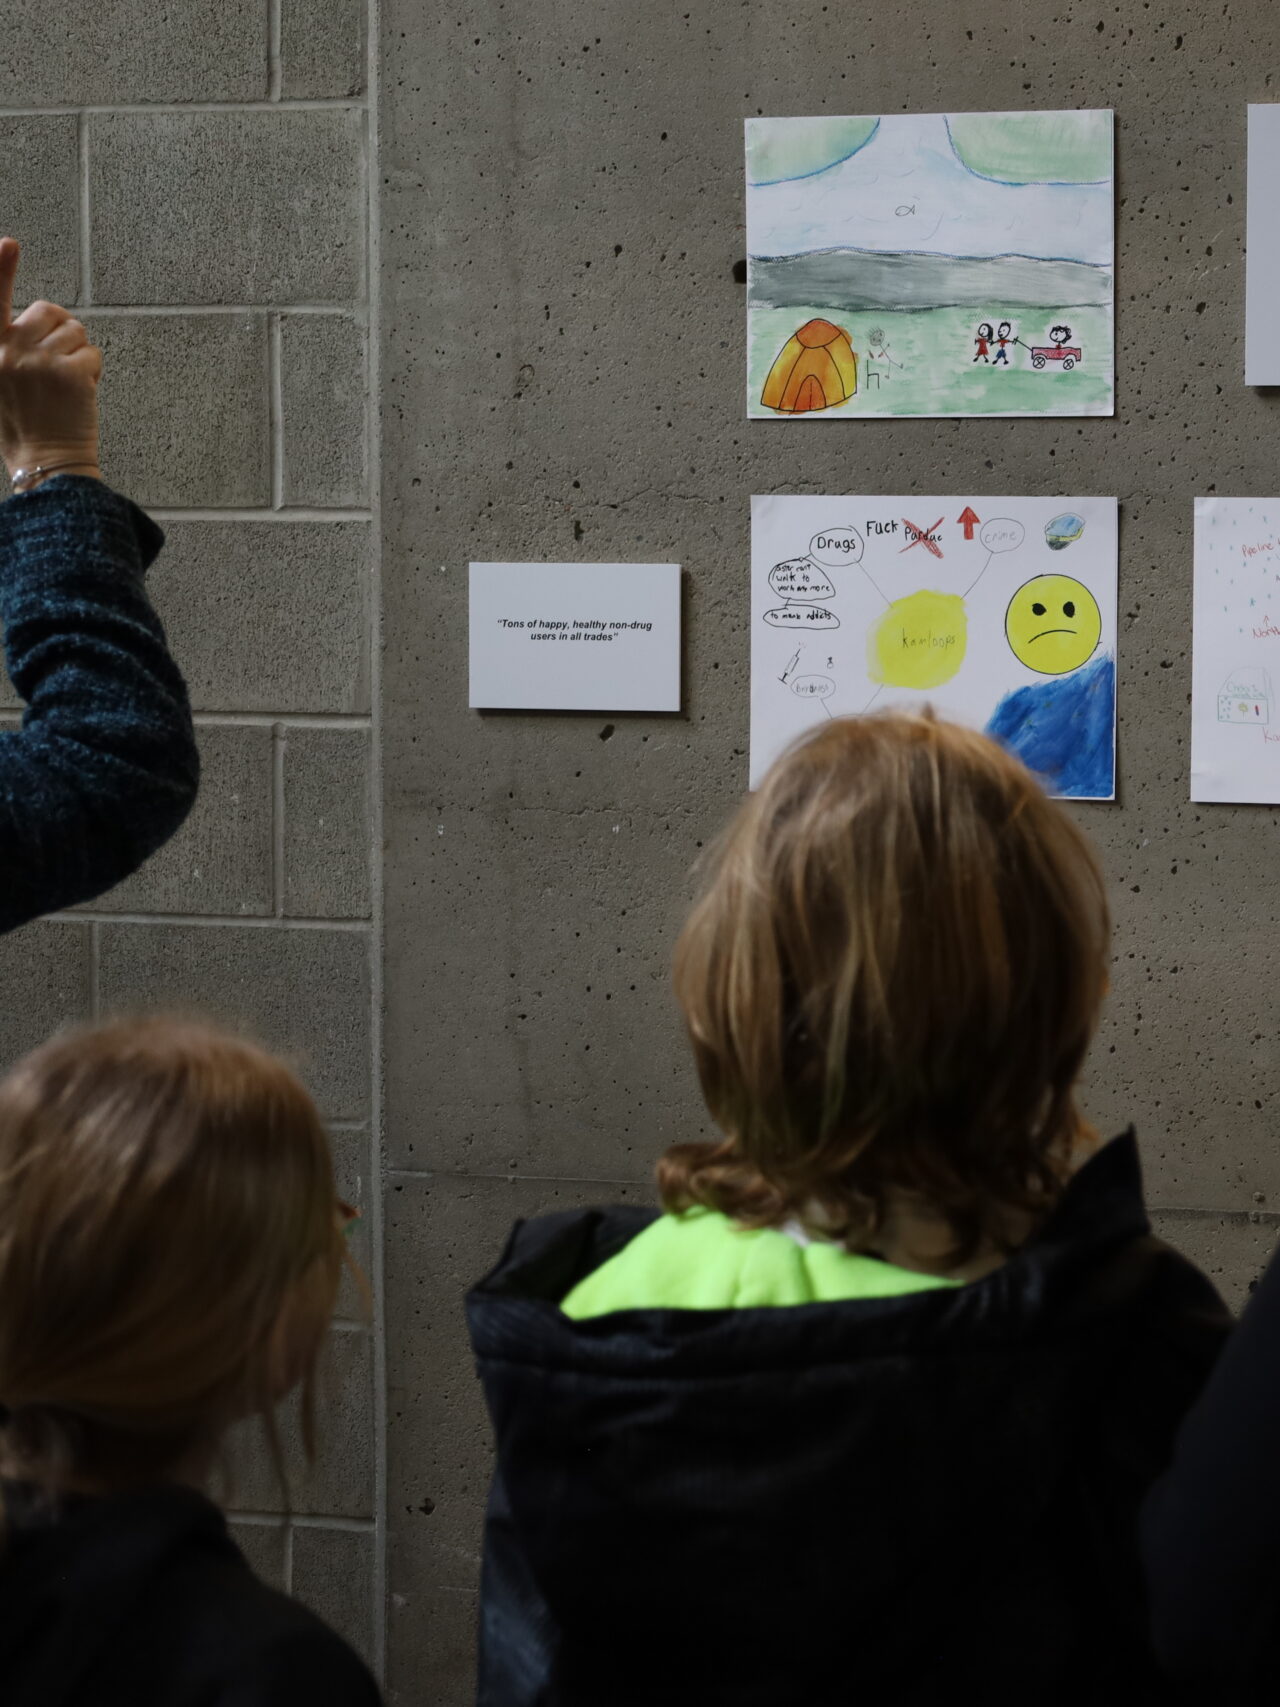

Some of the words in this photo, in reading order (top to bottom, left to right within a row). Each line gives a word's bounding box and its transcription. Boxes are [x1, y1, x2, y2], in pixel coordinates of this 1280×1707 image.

[866, 520, 898, 537] Fuck
[817, 536, 856, 553] Drugs
[802, 574, 810, 582] to
[527, 619, 537, 628] of
[539, 620, 570, 630] happy,
[573, 620, 606, 630] healthy
[609, 621, 652, 631] non-drug
[531, 632, 556, 640] users
[558, 632, 567, 640] in
[570, 632, 581, 640] all
